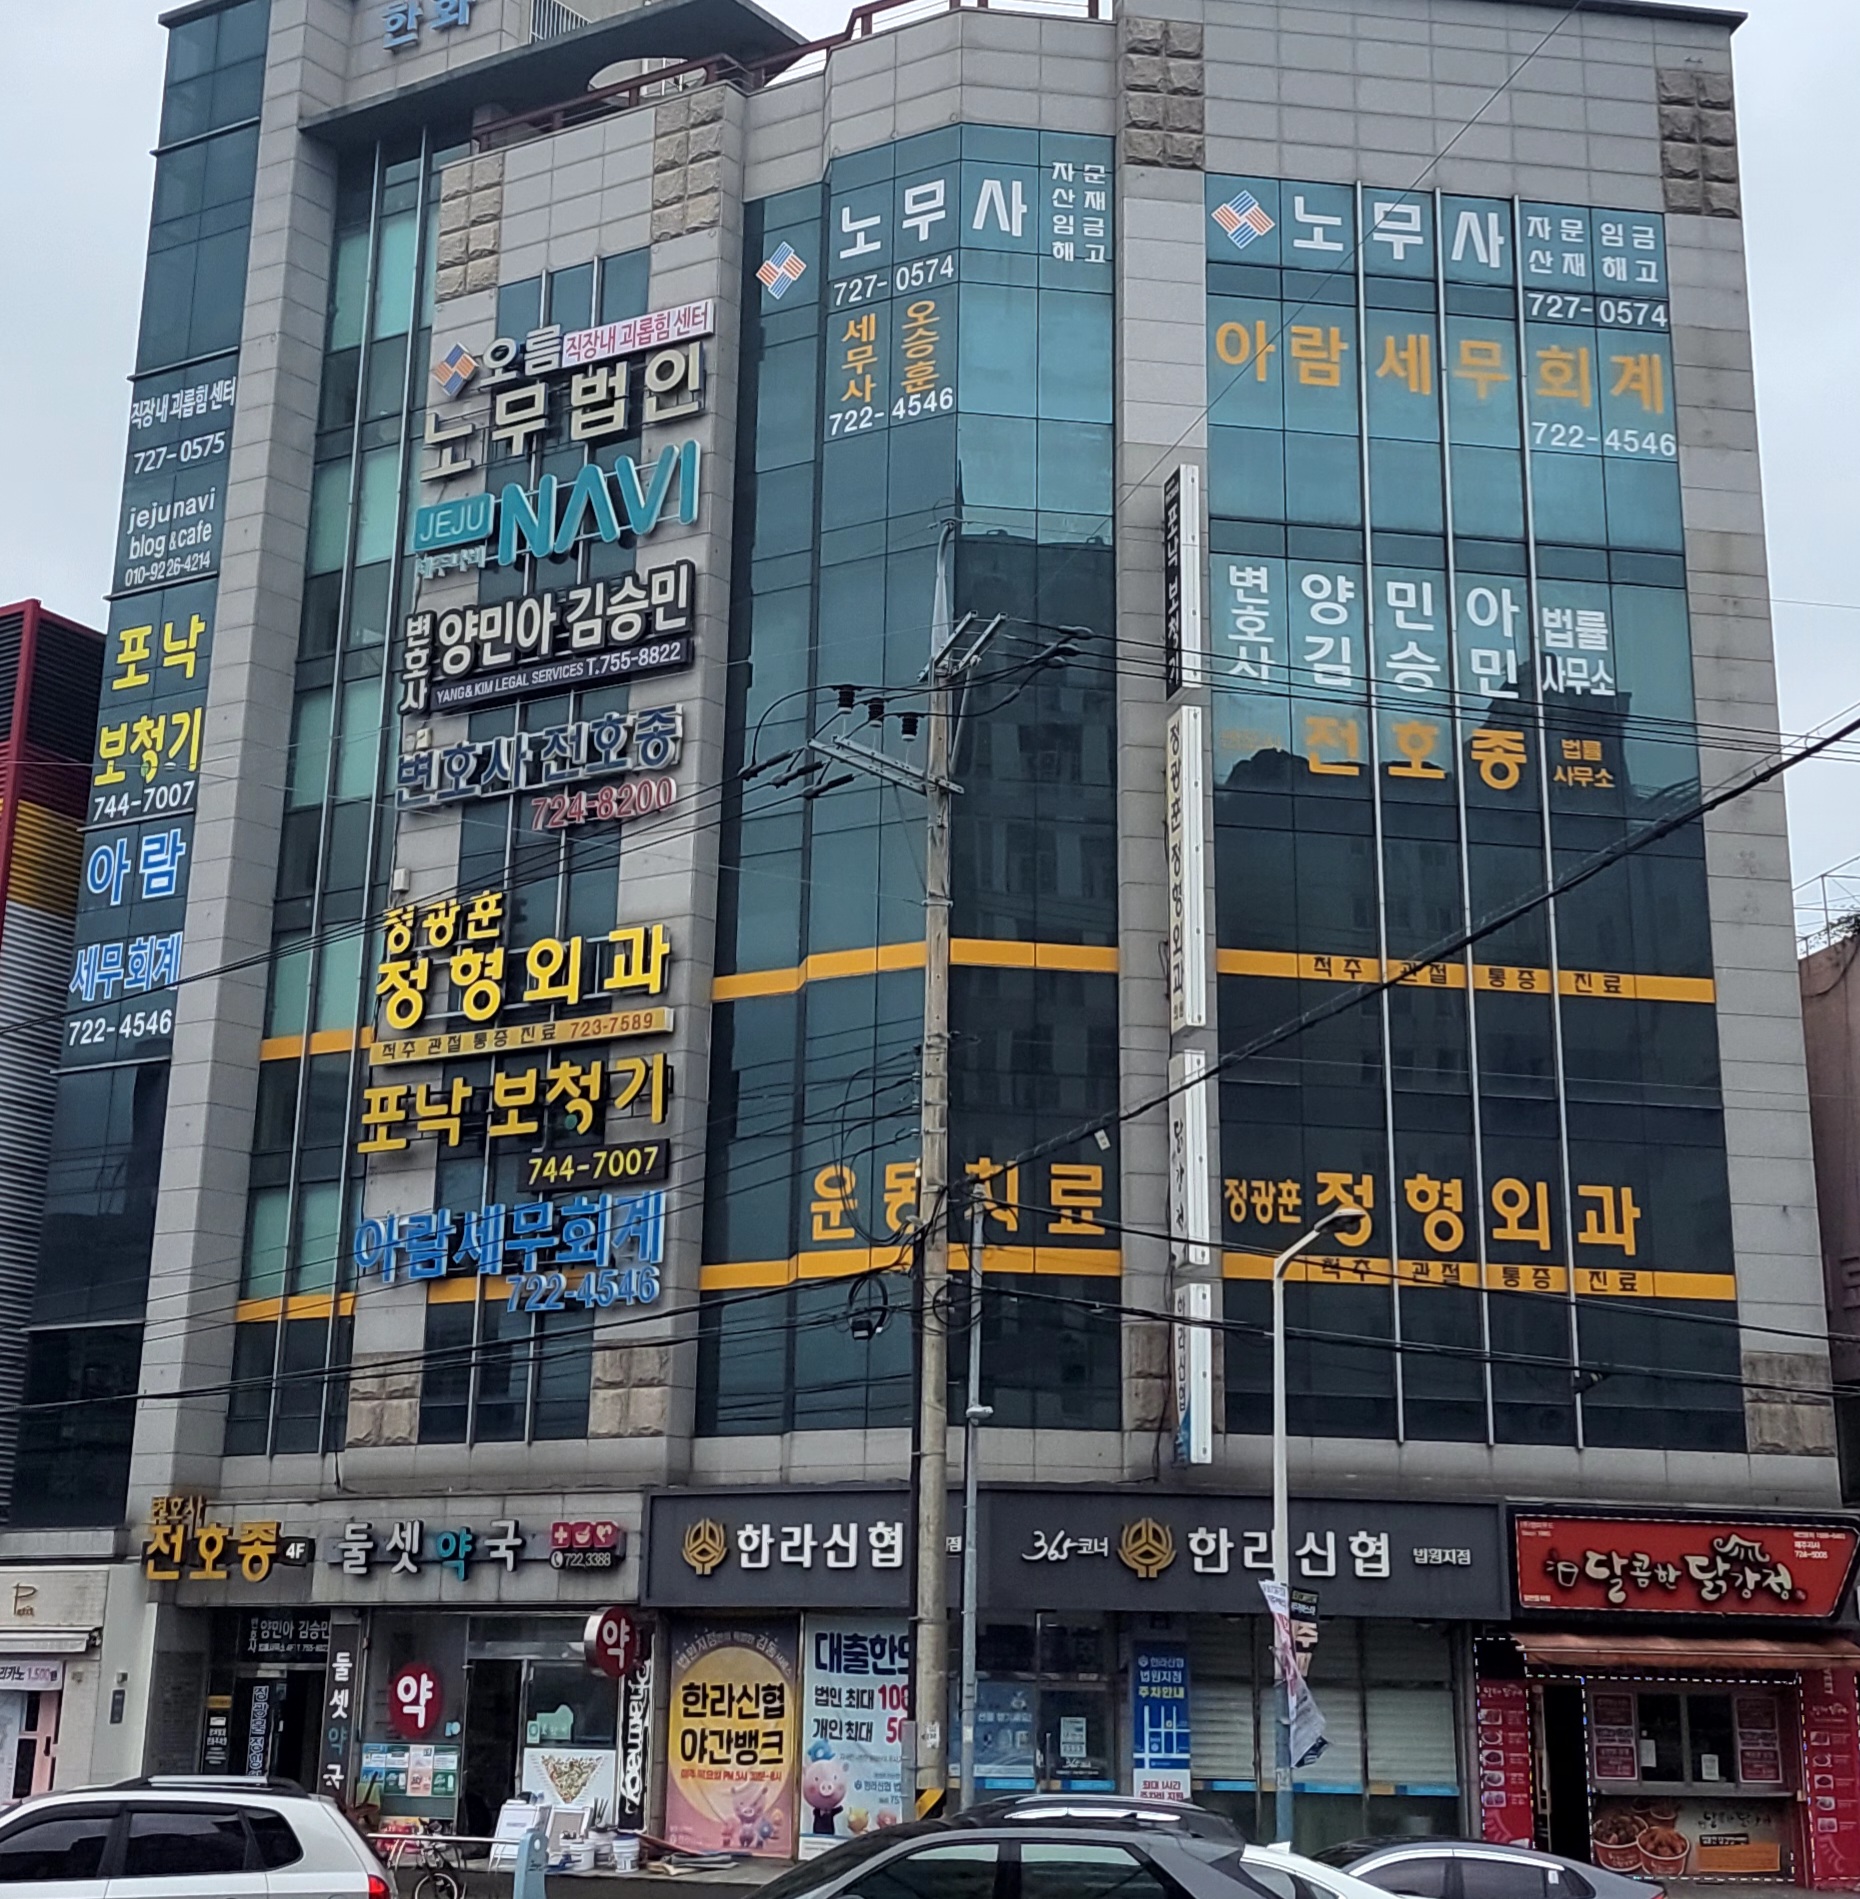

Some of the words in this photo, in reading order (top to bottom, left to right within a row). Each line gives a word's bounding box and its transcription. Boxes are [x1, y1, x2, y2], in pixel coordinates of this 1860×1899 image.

[838, 178, 1028, 260] 노무사
[1051, 187, 1106, 212] 산재
[1051, 214, 1105, 238] 임금
[1051, 240, 1106, 264] 해고
[1293, 195, 1504, 269] 노무사
[1600, 222, 1656, 251] 임금
[833, 254, 955, 307] 727-0574
[1528, 250, 1587, 278] 산재
[1602, 259, 1660, 285] 해고
[565, 326, 617, 360] 직장내
[619, 312, 672, 349] 괴롭힘
[673, 302, 710, 336] 센터
[1526, 293, 1669, 328] 727-0574
[480, 323, 562, 388] 오름
[840, 313, 878, 403] 세무사
[900, 300, 941, 394] 오승훈
[131, 392, 167, 430] 직장내
[209, 376, 236, 411] 센터
[420, 341, 704, 482] 노무법인
[829, 387, 954, 437] 722-4546
[133, 431, 226, 474] 727-0575
[1531, 421, 1677, 458] 722-4546
[420, 502, 485, 542] JEJU
[498, 439, 702, 566] NAVI
[125, 551, 210, 588] 010-9226-4214
[129, 533, 166, 561] blog
[438, 593, 556, 675] 양민아
[566, 562, 688, 649] 김승민
[1228, 564, 1274, 686] 변호사
[1300, 573, 1521, 638] 양민아
[1541, 606, 1610, 652] 법률
[112, 614, 206, 690] 포낙
[400, 614, 431, 712] 변호사
[495, 673, 529, 692] LEGAL
[532, 663, 584, 684] SERVICES
[1303, 635, 1520, 700] 김승민
[1541, 656, 1616, 697] 사무소
[93, 706, 203, 787] 보청기
[395, 732, 533, 809] 변호사
[541, 703, 685, 783] 전호종
[1305, 715, 1527, 790] 전호종
[1561, 738, 1602, 761] 법률
[93, 780, 196, 822] 744-7007
[532, 777, 677, 830] 724-8200
[1553, 765, 1615, 789] 사무소
[87, 828, 186, 906] 아람
[69, 931, 183, 1002] 세무회계
[376, 924, 670, 1029] 정형외과
[1488, 966, 1537, 990] 통증
[1574, 971, 1622, 994] 진료
[69, 1009, 172, 1046] 722-4546
[473, 1028, 509, 1050] 통증
[520, 1023, 557, 1044] 진료
[569, 1012, 655, 1039] 723-7589
[357, 1076, 472, 1154] 포낙
[489, 1052, 669, 1137] 보청기
[527, 1146, 659, 1186] 744-7007
[353, 1190, 668, 1283] 아람세무회계
[1224, 1178, 1302, 1225] 정광훈
[1316, 1171, 1641, 1257] 정형외과
[505, 1265, 660, 1312] 722-4546
[1411, 1262, 1460, 1286] 관절
[1501, 1265, 1552, 1290] 통증
[1588, 1270, 1637, 1293] 진료
[145, 1520, 279, 1583] 전호종
[285, 1542, 305, 1560] 4F
[337, 1519, 523, 1582] 둘셋약국
[736, 1521, 904, 1569] 한라신협
[1414, 1547, 1471, 1566] 법원지점
[1585, 1550, 1682, 1603] 달콤한
[1685, 1555, 1792, 1600] 닭강정
[260, 1620, 294, 1640] 양민아
[298, 1620, 330, 1640] 김승민
[602, 1617, 630, 1670] 약
[323, 1652, 353, 1790] 둘셋약국
[397, 1673, 434, 1729] 약
[681, 1682, 785, 1720] 한라신협
[814, 1685, 843, 1709] 법인
[844, 1685, 875, 1710] 최대
[680, 1728, 785, 1766] 야간뱅크
[812, 1718, 843, 1741] 개인
[845, 1720, 873, 1742] 최대
